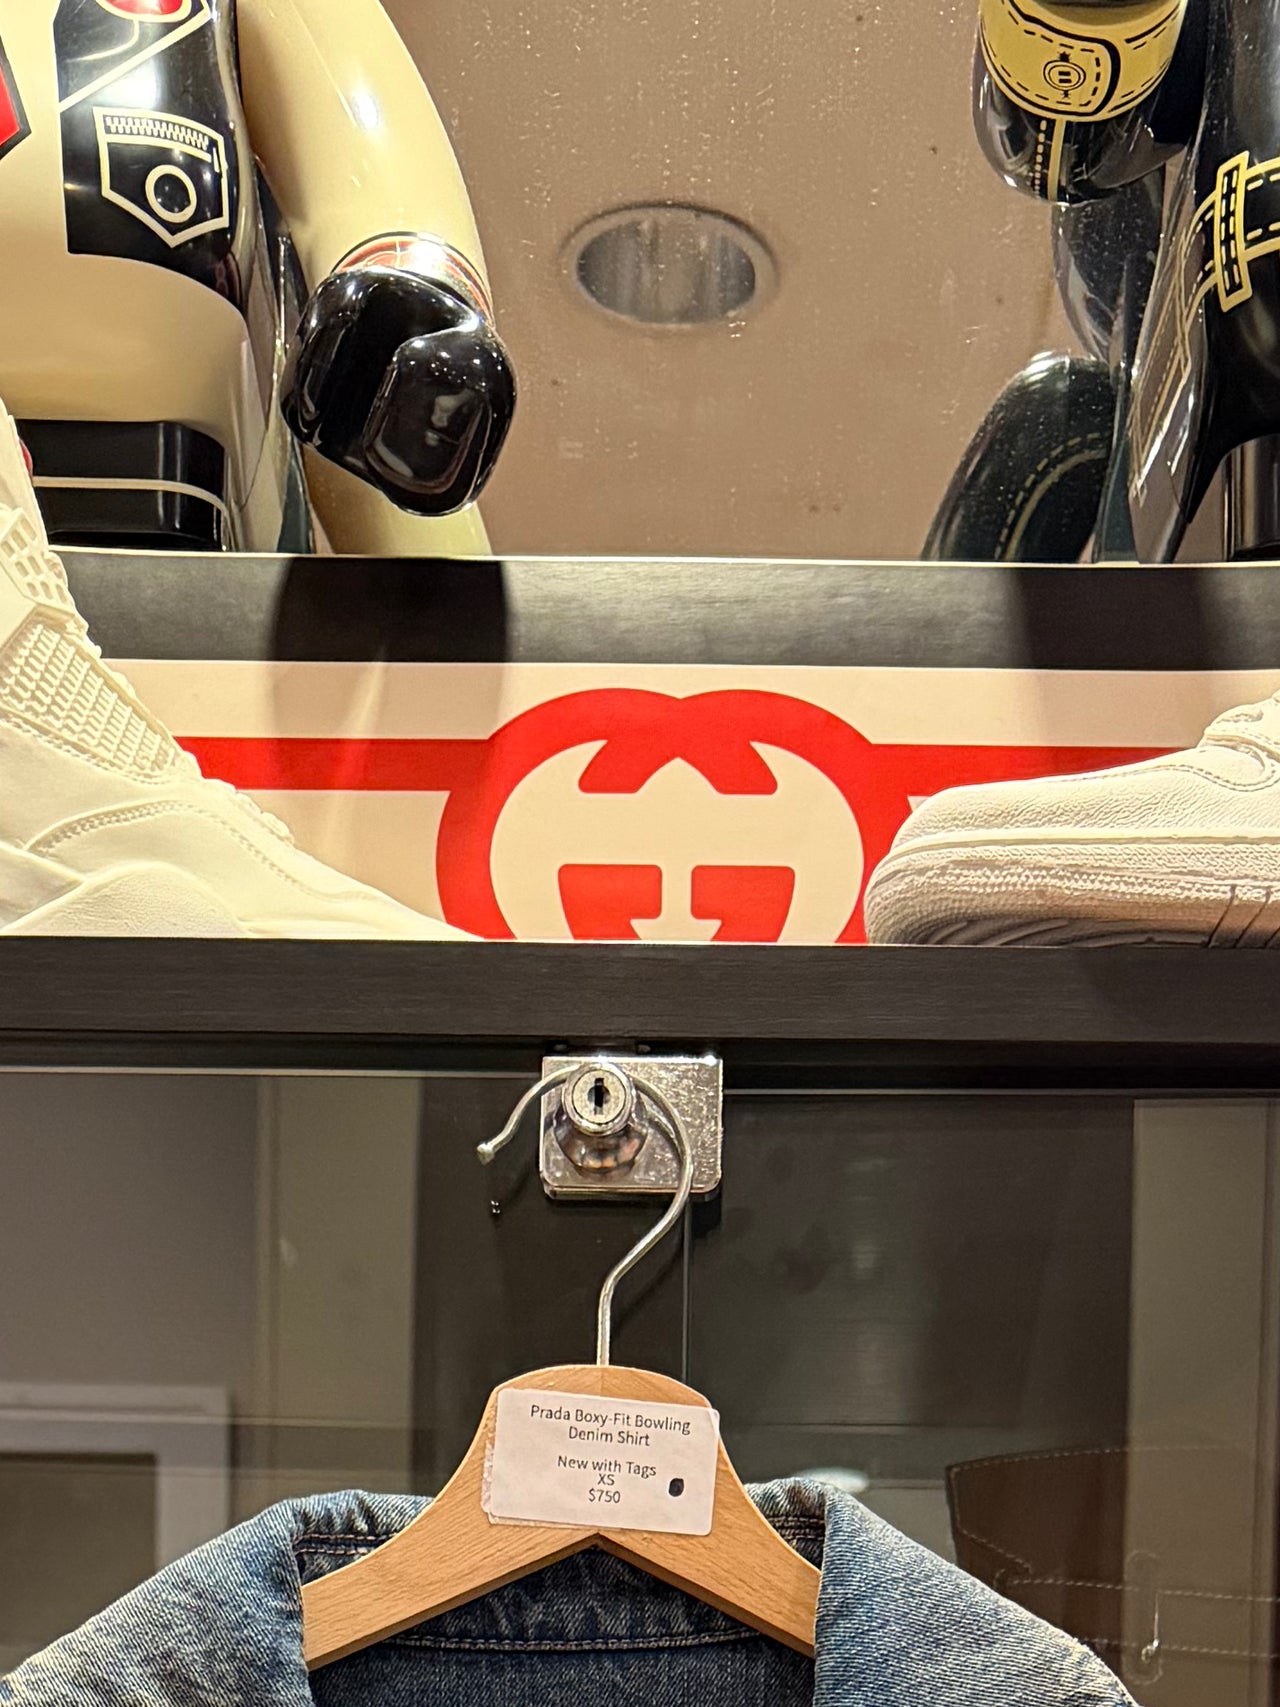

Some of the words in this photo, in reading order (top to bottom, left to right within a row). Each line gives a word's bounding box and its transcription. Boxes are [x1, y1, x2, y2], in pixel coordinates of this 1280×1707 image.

[530, 1404, 571, 1422] Prada
[574, 1409, 632, 1428] Boxy-Fit
[635, 1414, 692, 1436] Bowling
[568, 1426, 614, 1444] Denim
[617, 1431, 651, 1448] Shirt
[557, 1455, 588, 1471] New
[592, 1458, 622, 1474] with
[626, 1462, 657, 1480] Tags
[597, 1473, 616, 1487] XS
[588, 1488, 622, 1505] $750
